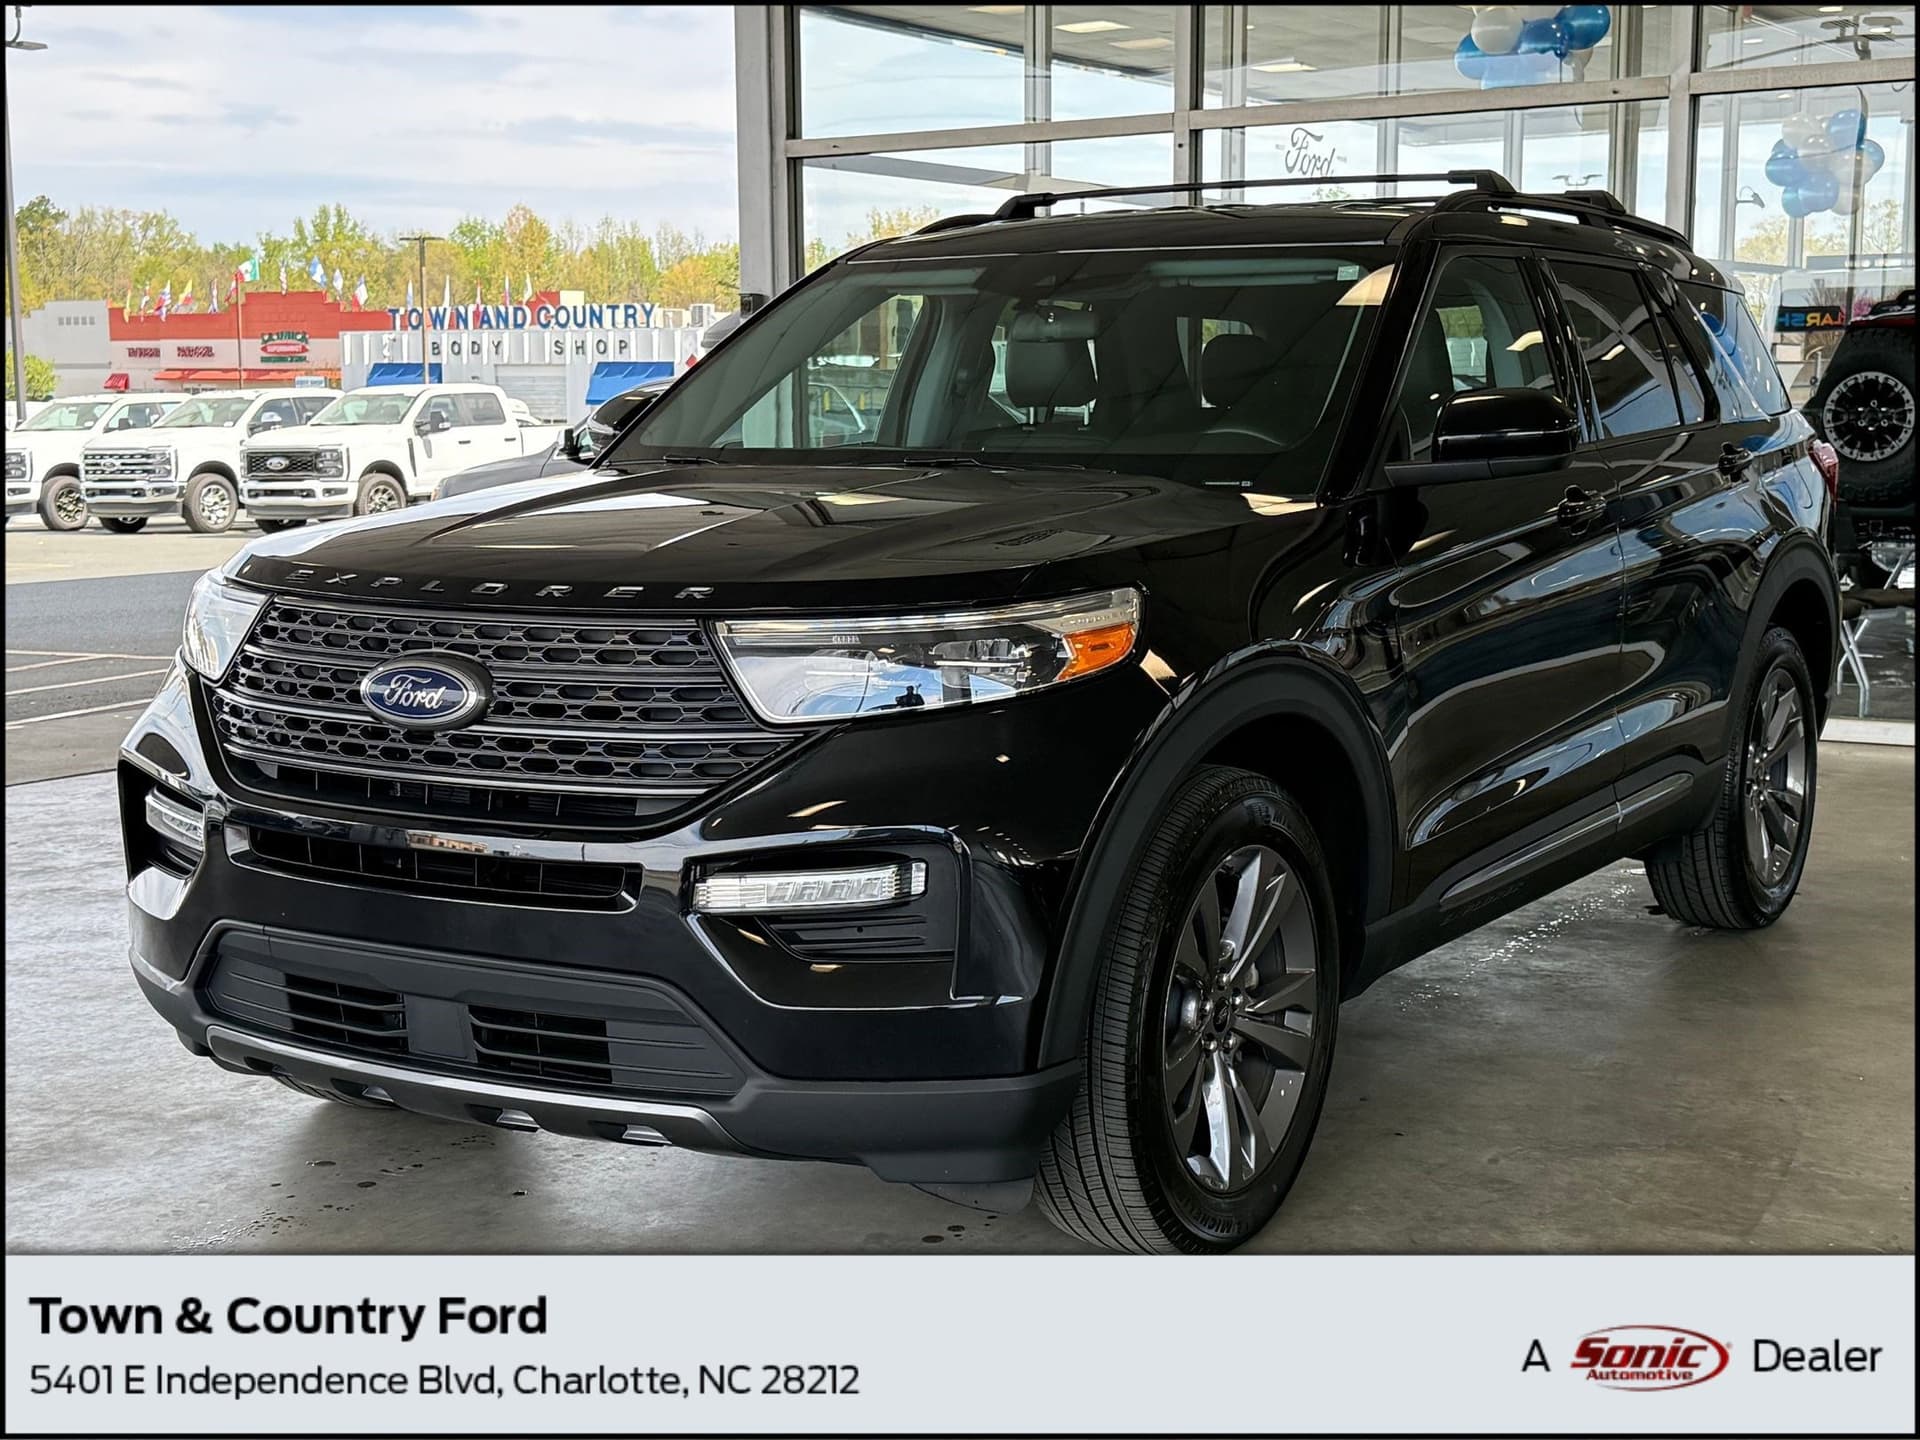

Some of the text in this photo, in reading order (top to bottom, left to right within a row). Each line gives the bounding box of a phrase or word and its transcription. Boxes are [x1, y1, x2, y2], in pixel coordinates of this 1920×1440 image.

[1285, 127, 1336, 177] Ford
[388, 303, 656, 331] TOWN AND COUNTRY
[431, 339, 629, 357] BODY SHOP
[285, 569, 715, 600] EXPLORER
[383, 673, 448, 710] Ford
